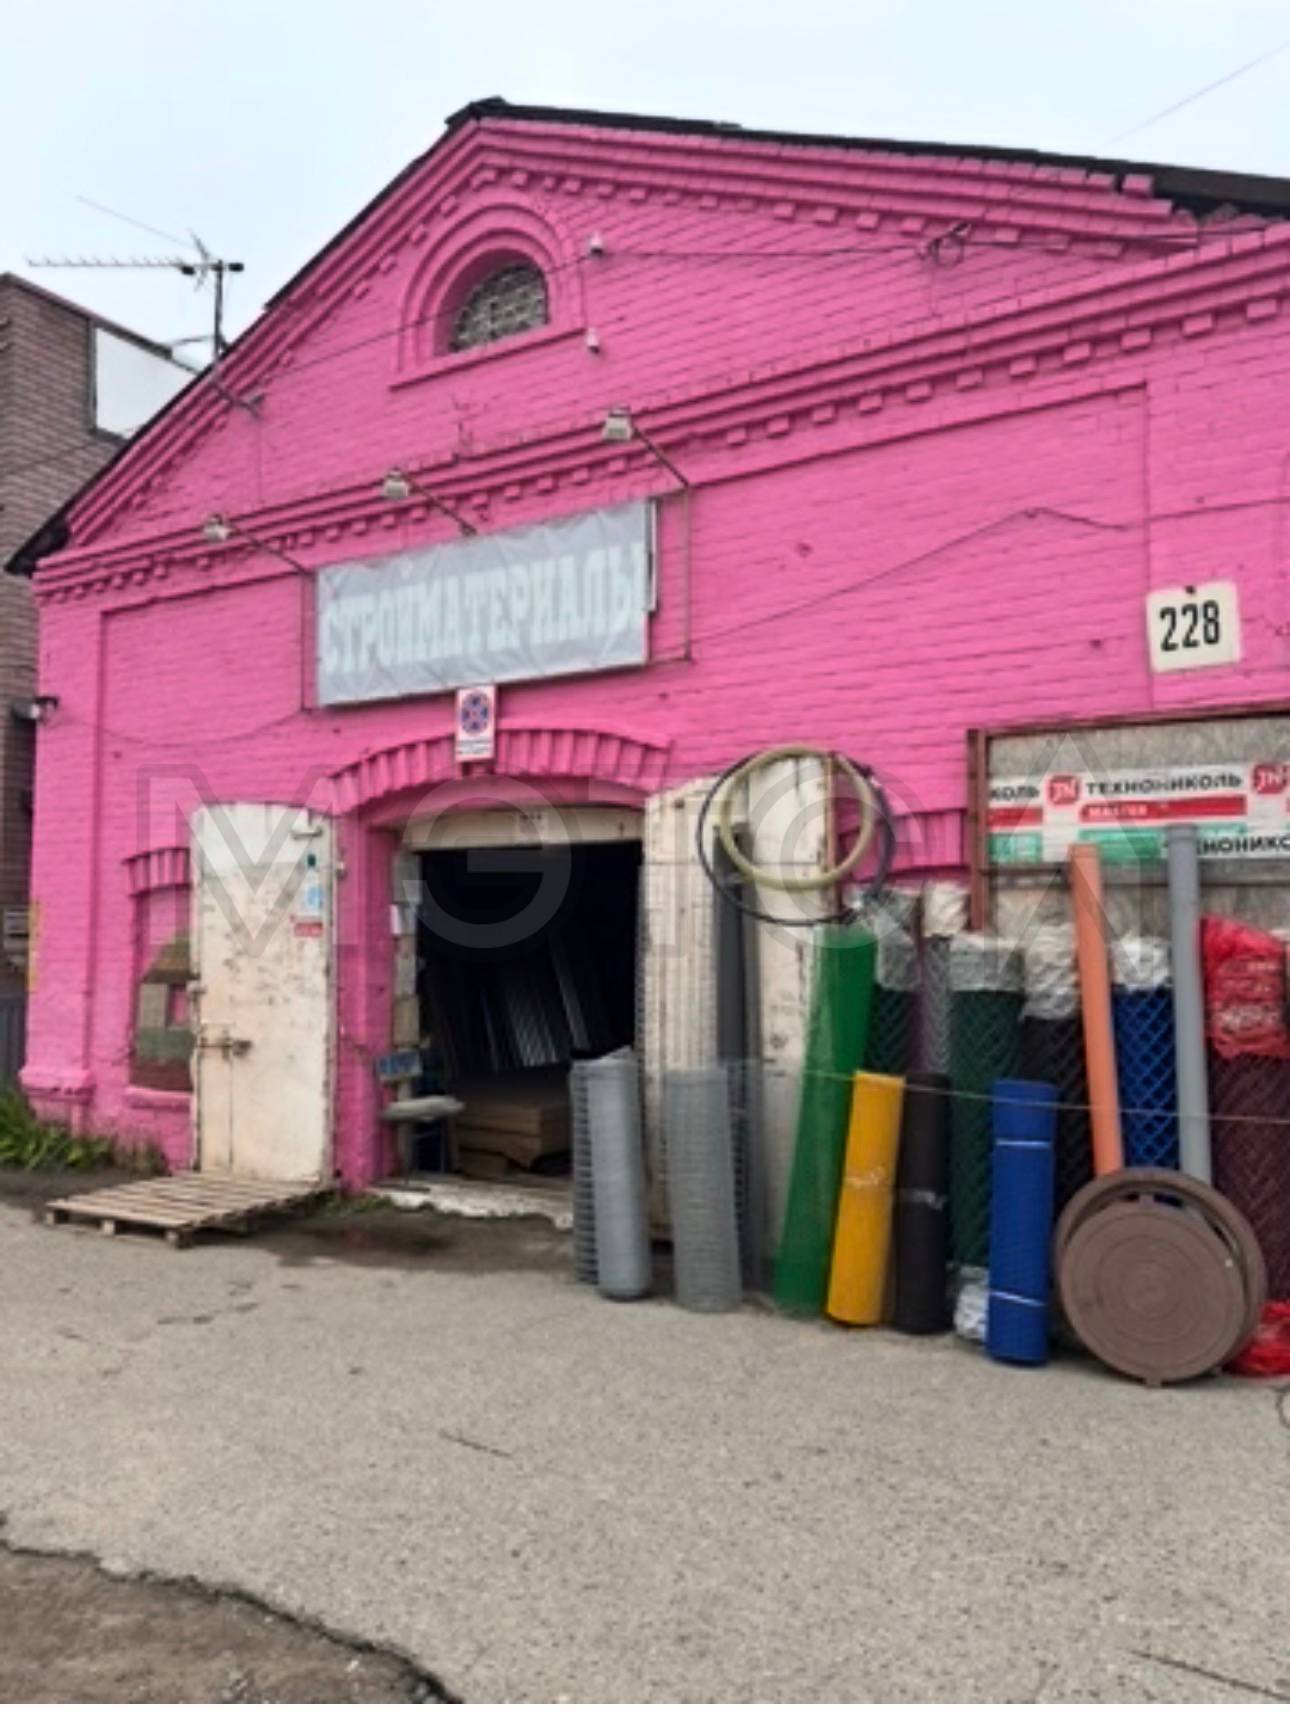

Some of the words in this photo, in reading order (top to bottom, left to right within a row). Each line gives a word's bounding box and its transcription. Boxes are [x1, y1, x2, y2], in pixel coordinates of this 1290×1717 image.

[322, 542, 645, 675] СТРОЙМАТЕРИАЛЫ
[1160, 600, 1220, 652] 228
[1086, 773, 1242, 795] ТЕХНОНИКОЛЬ
